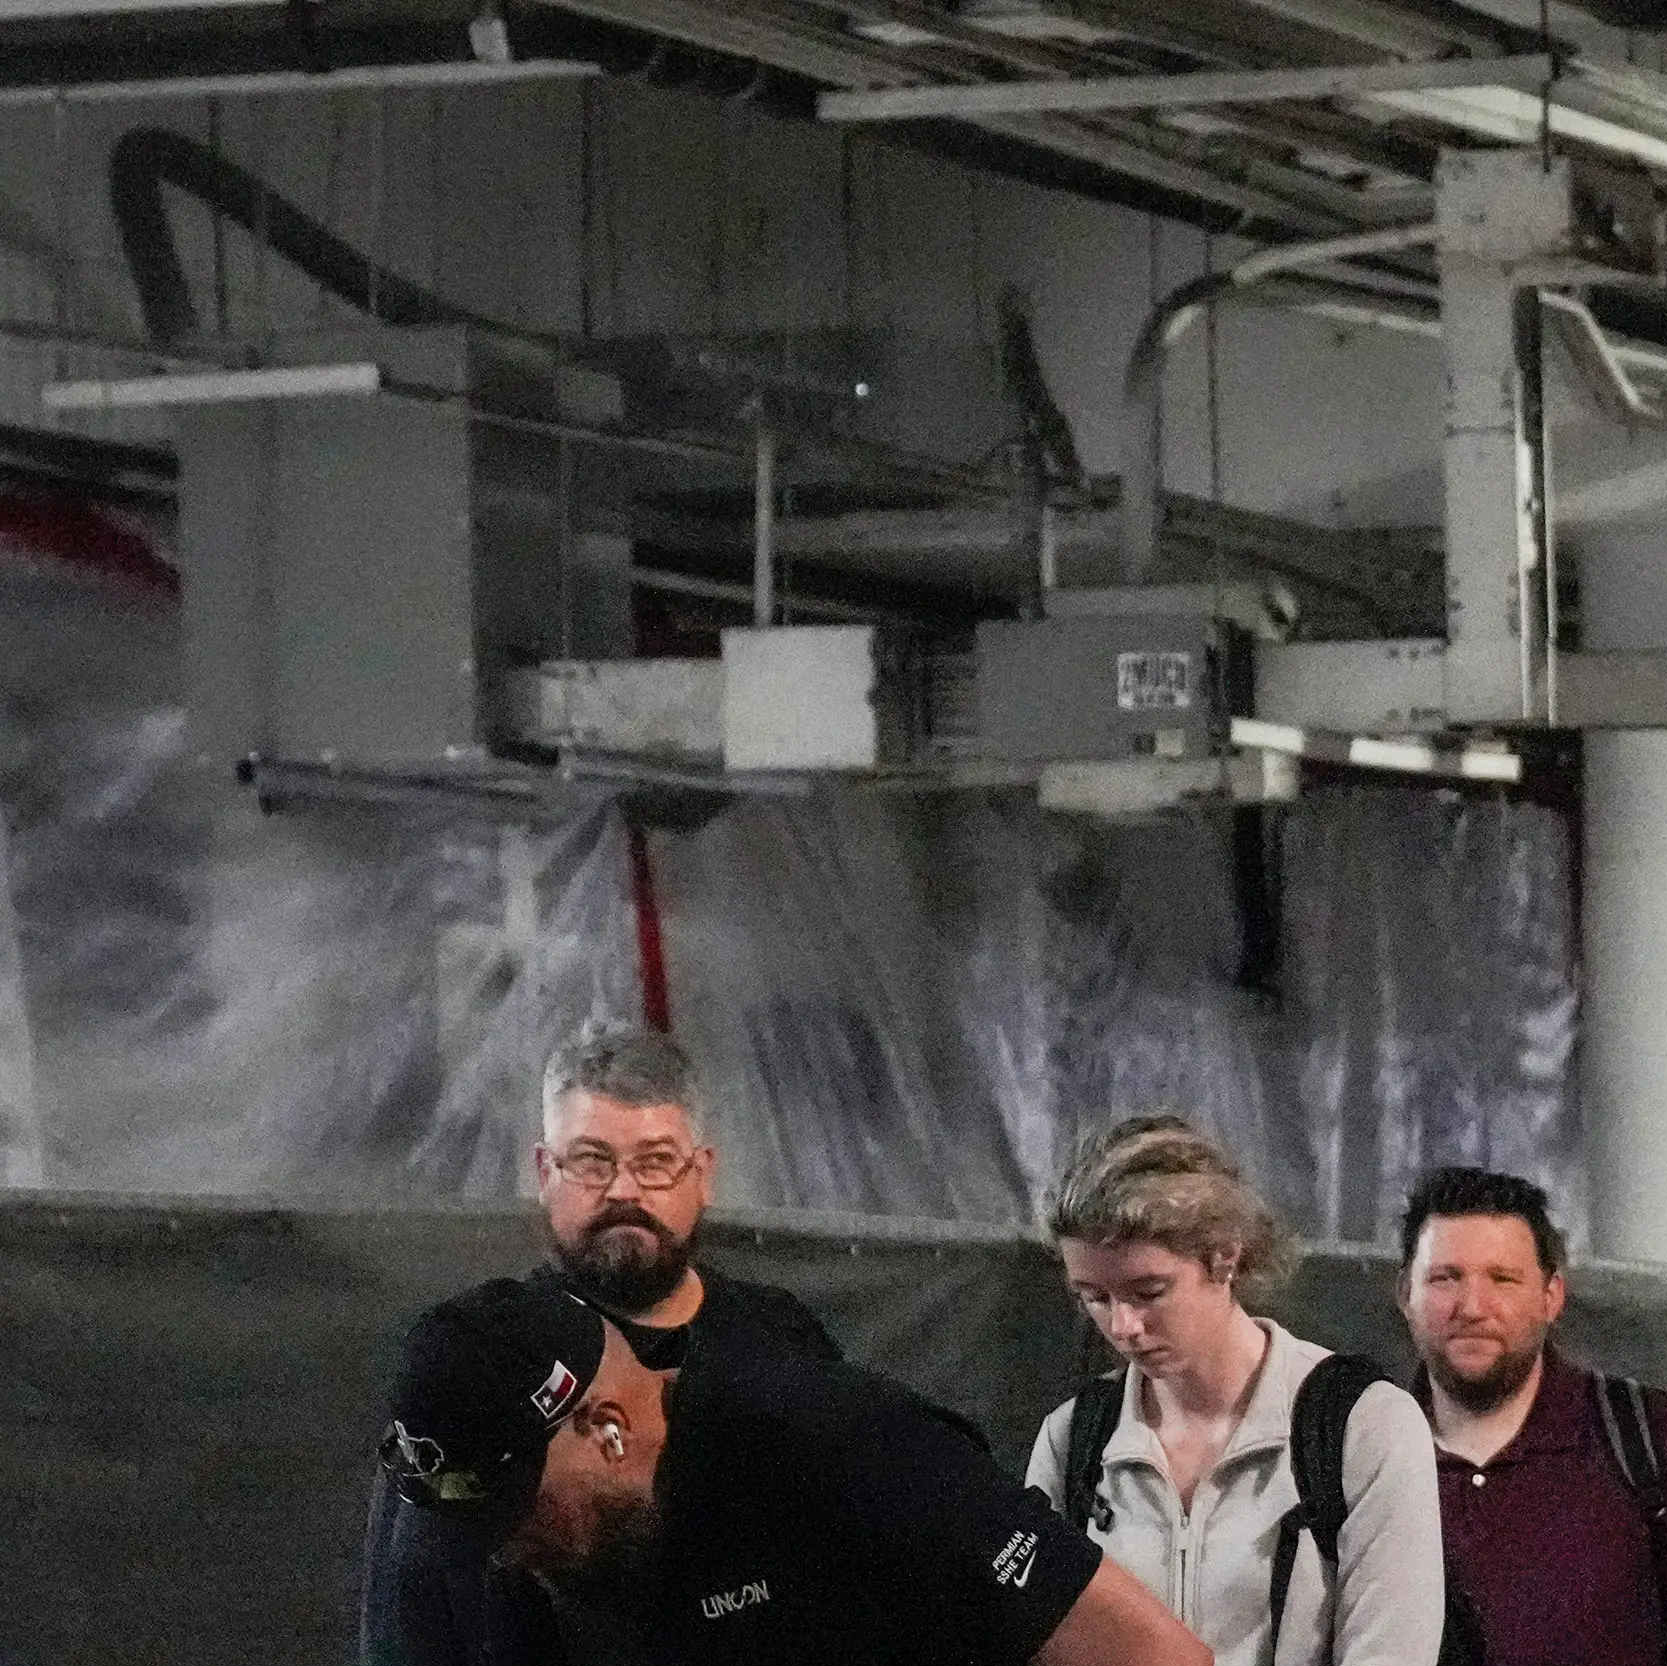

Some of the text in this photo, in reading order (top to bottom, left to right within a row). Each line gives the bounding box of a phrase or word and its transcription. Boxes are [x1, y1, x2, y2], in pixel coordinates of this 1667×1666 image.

[992, 1530, 1024, 1571] PERMIAN
[997, 1532, 1038, 1584] SSHE TEAM
